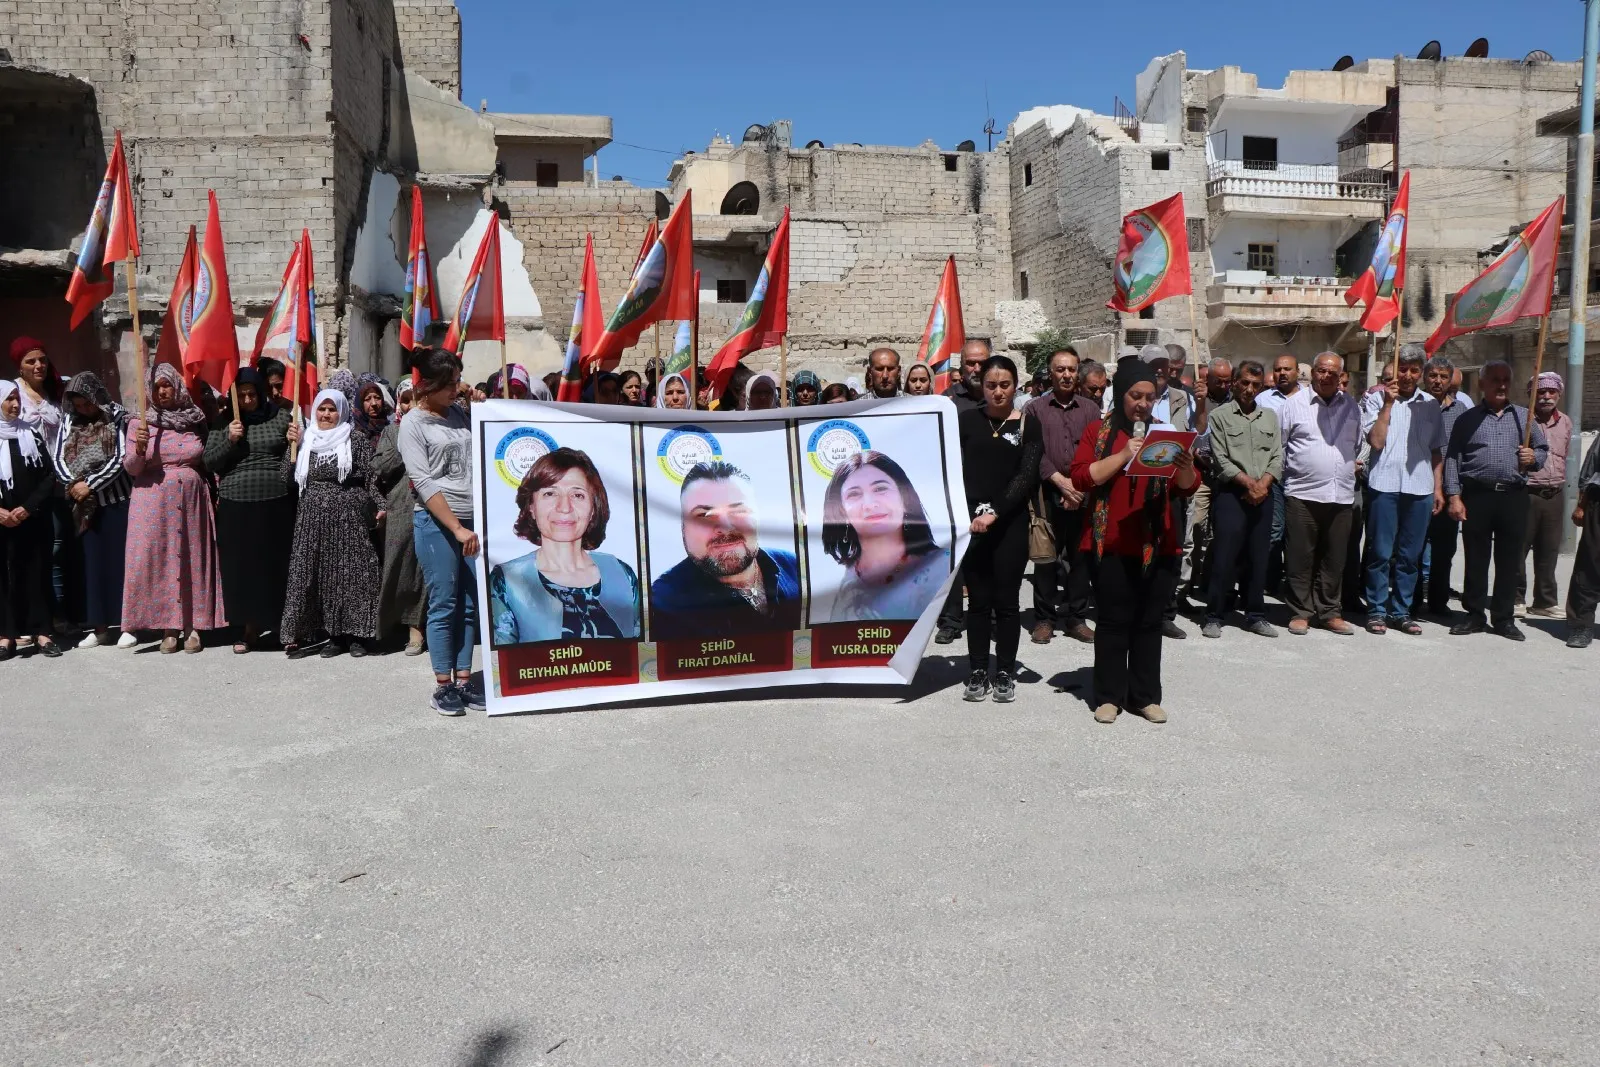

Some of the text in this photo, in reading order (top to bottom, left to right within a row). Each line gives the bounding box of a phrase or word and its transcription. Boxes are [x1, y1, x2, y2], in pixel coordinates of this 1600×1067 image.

[857, 626, 891, 641] ŞEHÎD
[549, 644, 583, 662] ŞEHÎD
[701, 638, 735, 654] ŞEHÎD
[832, 644, 869, 655] YUSRA
[678, 652, 755, 668] FIRAT DANÎAL
[519, 659, 612, 679] REIYHAN AMÛDE
